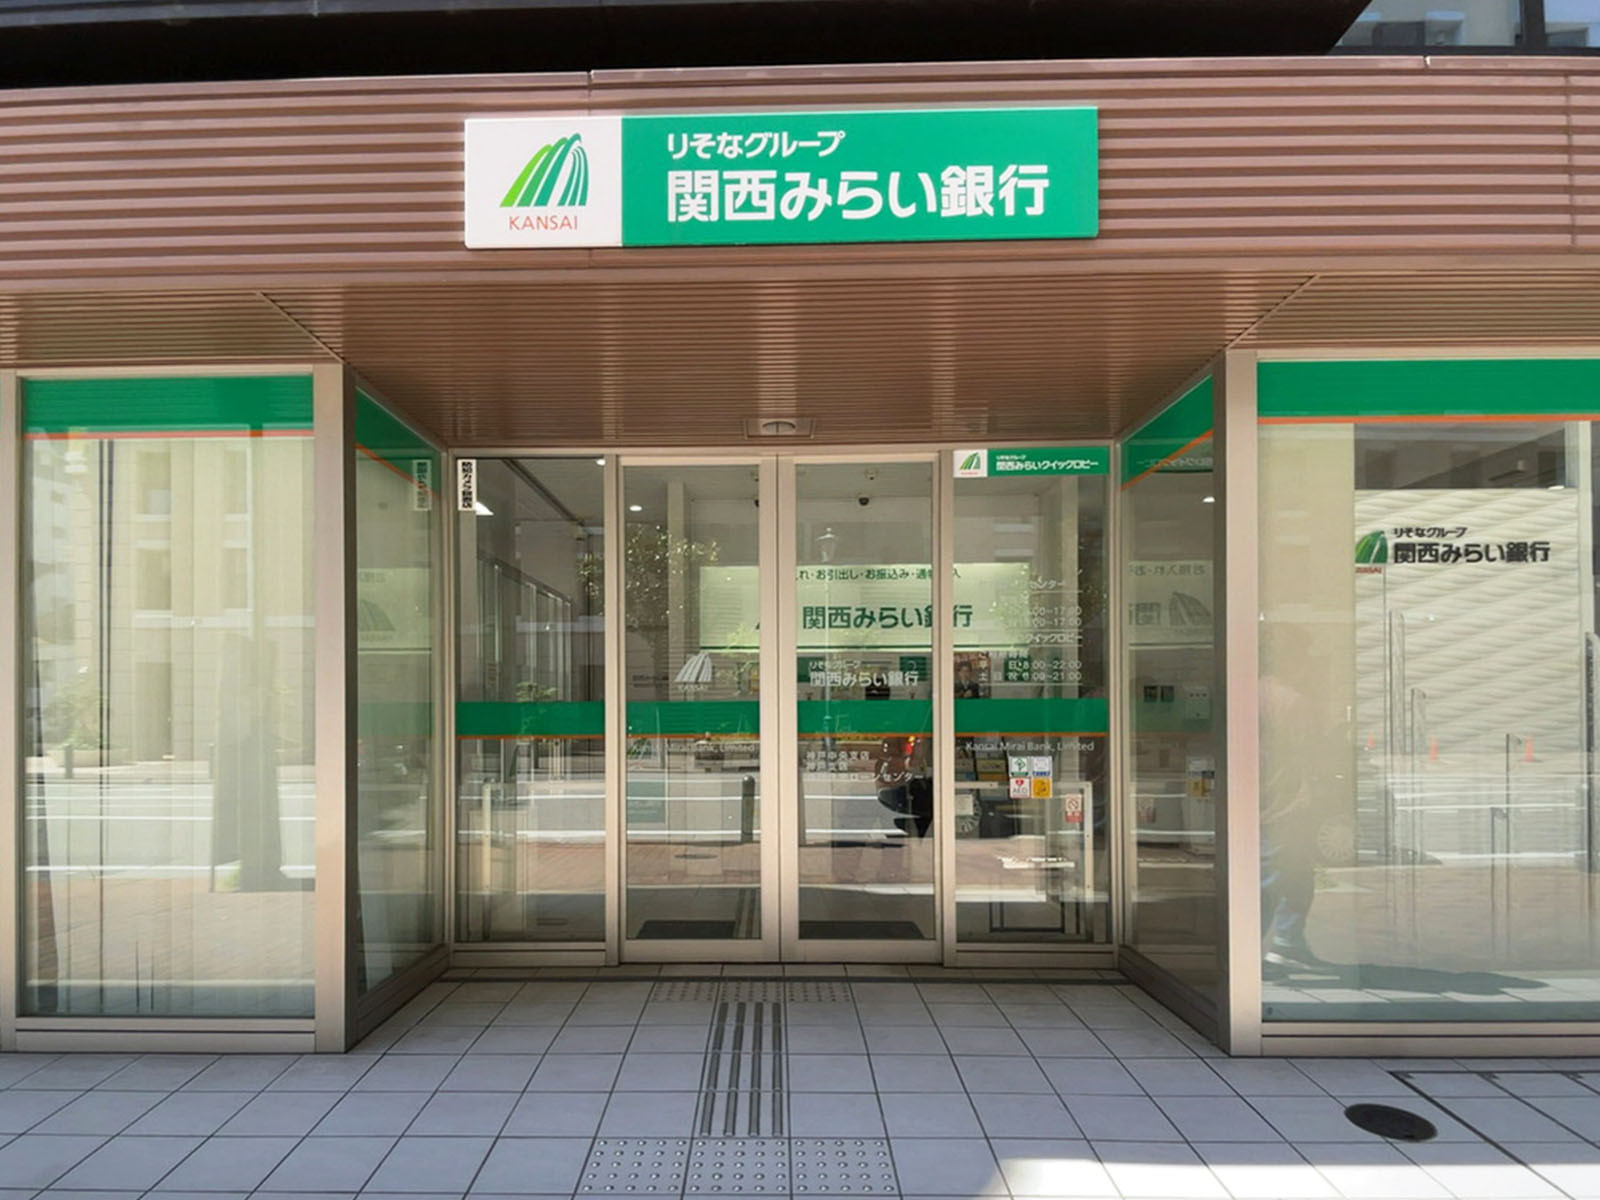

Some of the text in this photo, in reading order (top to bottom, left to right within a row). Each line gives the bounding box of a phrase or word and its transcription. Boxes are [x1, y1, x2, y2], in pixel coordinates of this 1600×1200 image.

[666, 130, 846, 160] りそなグループ
[666, 163, 1049, 224] 関西みらい銀行
[509, 214, 578, 231] KANSAI
[1393, 540, 1551, 564] 関西みらい銀行
[809, 670, 920, 688] 関西みらい銀行
